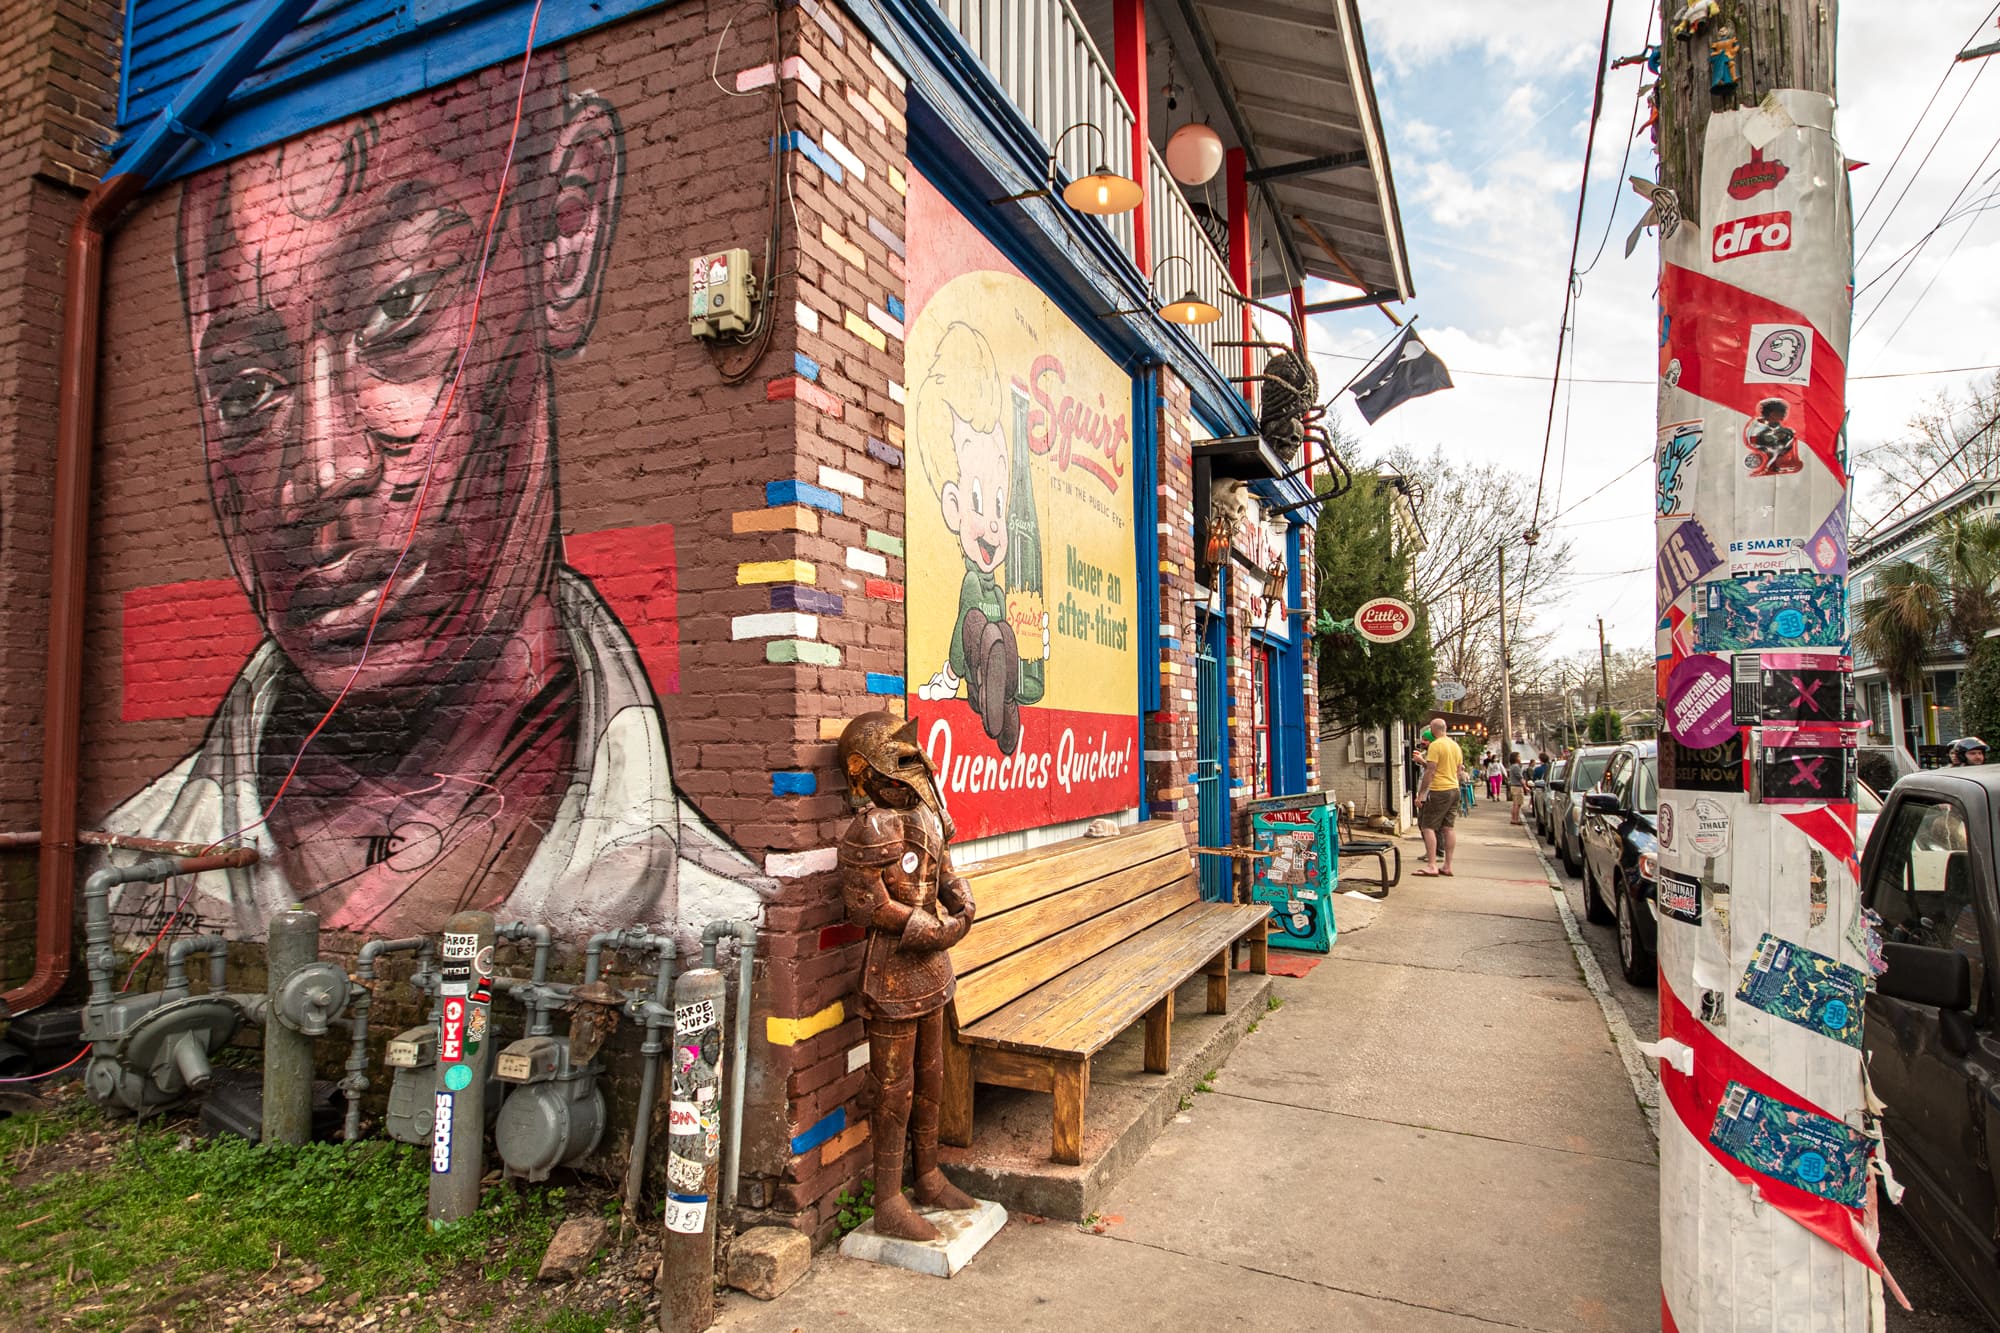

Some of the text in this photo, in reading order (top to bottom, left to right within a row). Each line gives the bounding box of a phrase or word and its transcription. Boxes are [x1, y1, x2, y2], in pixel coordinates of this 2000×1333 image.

[1714, 222, 1790, 258] dro
[1027, 354, 1129, 478] Squirt
[1075, 486, 1087, 503] THE
[1089, 495, 1110, 518] PUBLIC
[1730, 538, 1792, 552] BE SMART
[1066, 544, 1121, 605] Never an
[1731, 560, 1785, 572] EAT MORE
[1006, 601, 1043, 634] Squirt
[1058, 592, 1128, 652] after-thirst
[1363, 609, 1405, 623] Little's
[1674, 671, 1717, 718] POWERING
[1676, 674, 1732, 736] PRESERVATION
[927, 718, 1132, 809] Quenches Quicker!
[1700, 767, 1739, 782] NOW
[676, 1001, 712, 1021] BAROE
[444, 1001, 462, 1058] OYE
